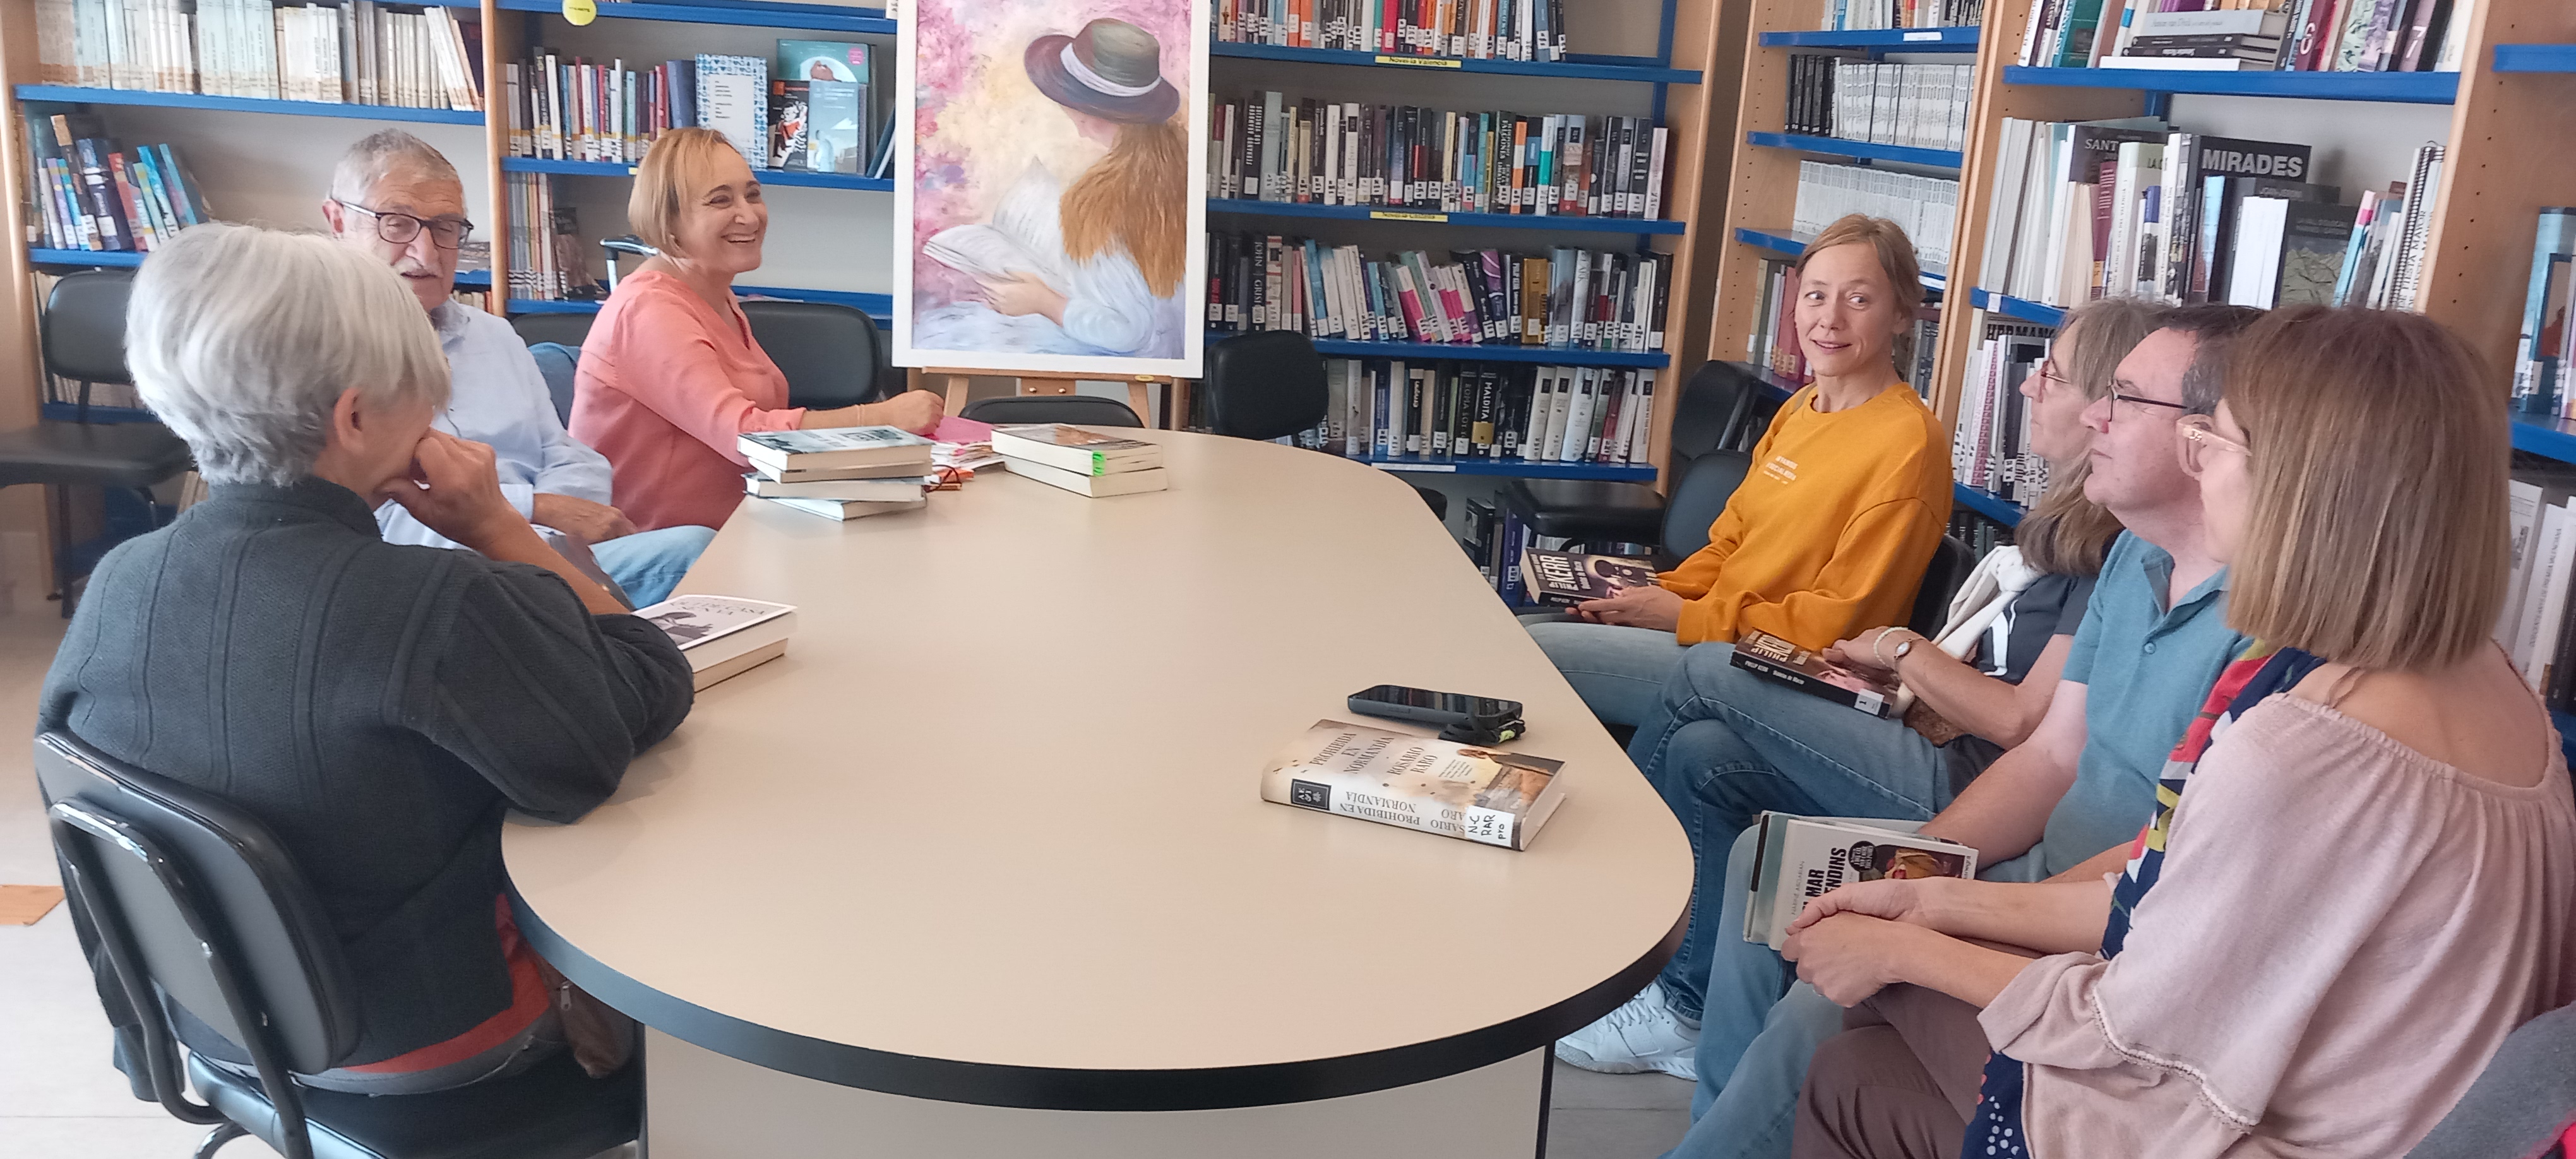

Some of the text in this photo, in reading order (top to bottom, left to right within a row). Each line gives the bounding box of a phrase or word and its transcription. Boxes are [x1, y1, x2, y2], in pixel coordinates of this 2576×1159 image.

[2202, 148, 2304, 177] MIRADES
[2411, 210, 2426, 250] MAYOR
[1255, 242, 1263, 267] JOHN
[1463, 383, 1472, 409] ROMA
[1481, 382, 1493, 420] MALDITA
[1539, 555, 1579, 591] PHILIP KERR
[1750, 647, 1789, 663] PHILIP
[1309, 732, 1357, 766] PROHIBIDA
[1341, 747, 1361, 758] EN
[1343, 736, 1395, 775] NORMANDÍA
[1386, 747, 1425, 775] ROSARIO
[1410, 754, 1438, 774] RARO
[1339, 802, 1465, 833] SARIO PROHIBIDA EN
[1346, 791, 1466, 821] ARO NORMANDÍA
[1481, 814, 1496, 836] RAR
[1497, 823, 1507, 840] pro
[1804, 868, 1825, 898] MAR
